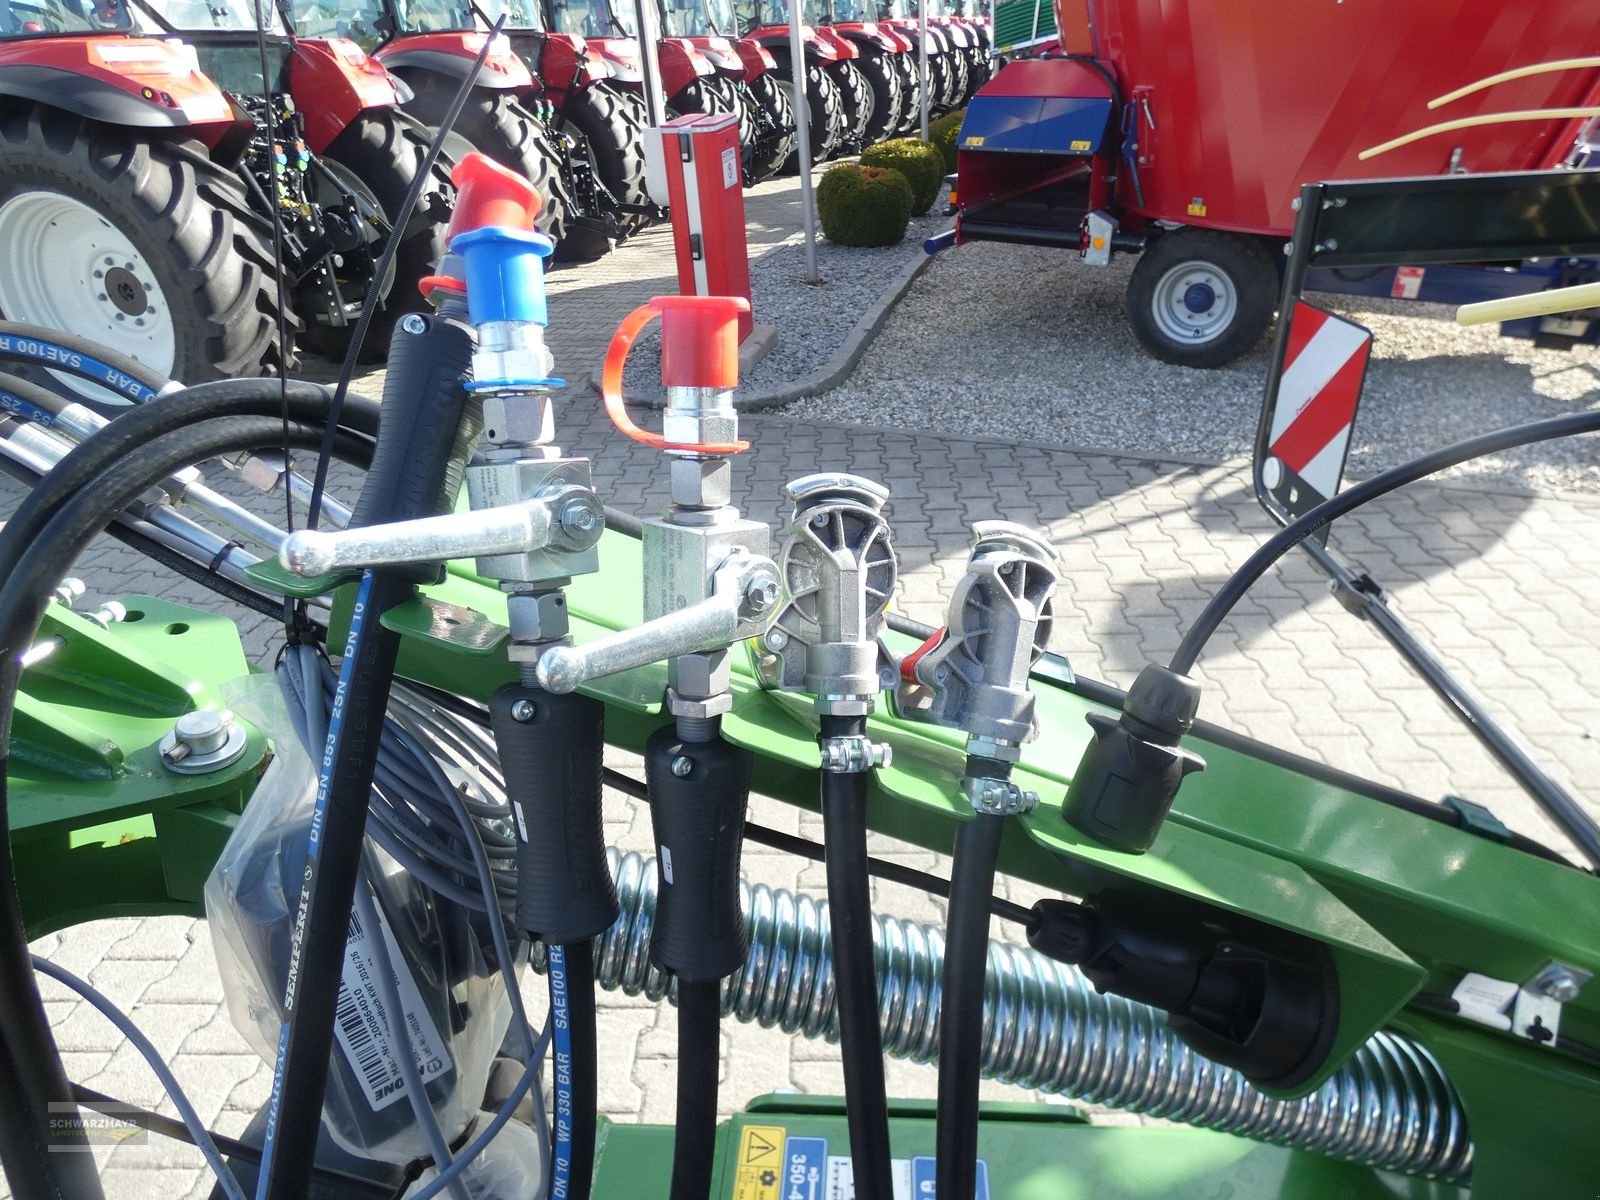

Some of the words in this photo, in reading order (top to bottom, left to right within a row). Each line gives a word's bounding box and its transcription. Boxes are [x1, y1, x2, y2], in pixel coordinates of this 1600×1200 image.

[17, 341, 81, 368] SAE100
[106, 370, 141, 395] BAR
[32, 410, 54, 426] 53
[309, 808, 321, 844] DIN
[316, 770, 330, 799] EN
[323, 734, 336, 766] 853
[332, 680, 346, 718] 2SN
[344, 631, 358, 658] DN
[352, 602, 365, 622] 10
[284, 885, 310, 1010] SEMPERIT
[350, 951, 370, 982] 2016/26
[353, 988, 382, 1039] 200864010
[552, 971, 568, 1030] SAE100
[557, 1052, 570, 1084] BAR
[558, 1090, 570, 1116] 330
[557, 1119, 570, 1143] WP
[556, 1157, 569, 1172] 10
[553, 1174, 567, 1199] DN
